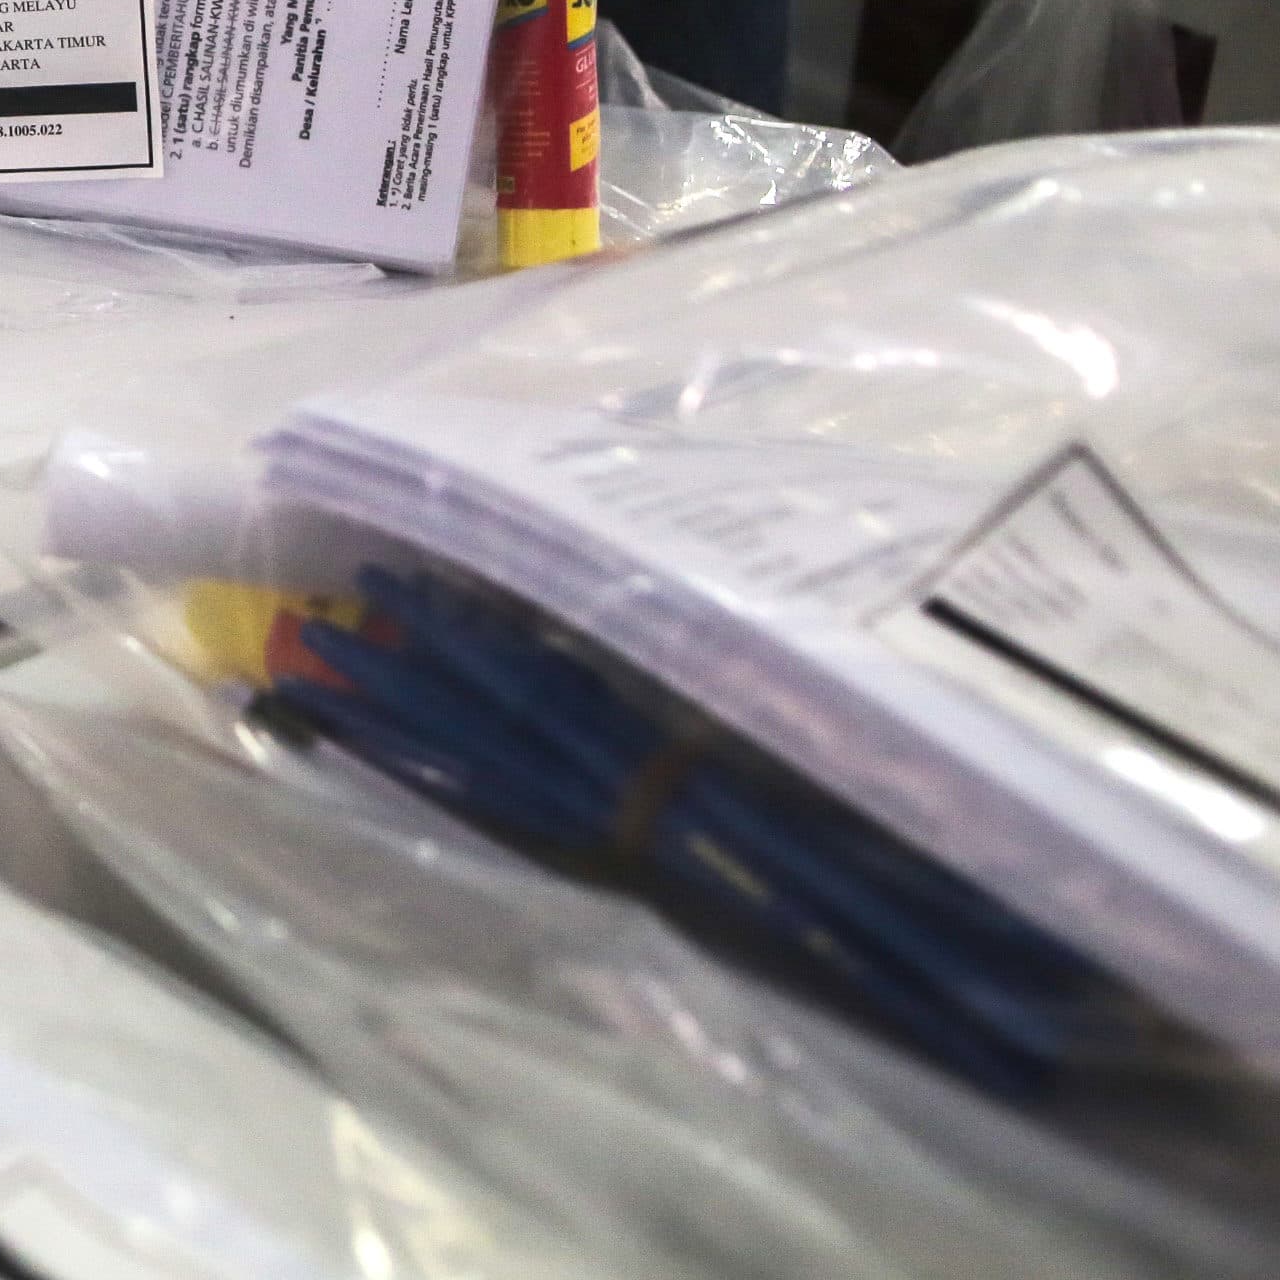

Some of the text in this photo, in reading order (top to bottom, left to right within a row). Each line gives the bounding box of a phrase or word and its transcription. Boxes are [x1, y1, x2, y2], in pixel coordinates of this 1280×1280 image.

[57, 35, 107, 50] TIMUR
[243, 18, 257, 32] di
[279, 11, 297, 45] Yang
[393, 17, 412, 54] Nama
[439, 20, 454, 50] untuk
[181, 31, 203, 91] rangkap
[230, 34, 254, 112] diumumkan
[249, 20, 276, 105] disampaikan,
[290, 34, 310, 82] Panitia
[422, 57, 436, 81] Hasil
[433, 51, 450, 92] rangkap
[298, 28, 327, 140] Desa Kelurahan
[174, 92, 193, 134] (satu)
[190, 83, 211, 133] C.HASIL
[413, 83, 432, 140] Penerimaan
[428, 93, 443, 121] (satu)
[223, 114, 240, 152] untuk
[238, 106, 261, 168] Demikian
[392, 107, 414, 186] Coret yang tidak
[408, 141, 422, 169] Acara
[416, 131, 437, 201] masing-masing
[403, 171, 417, 199] Berita
